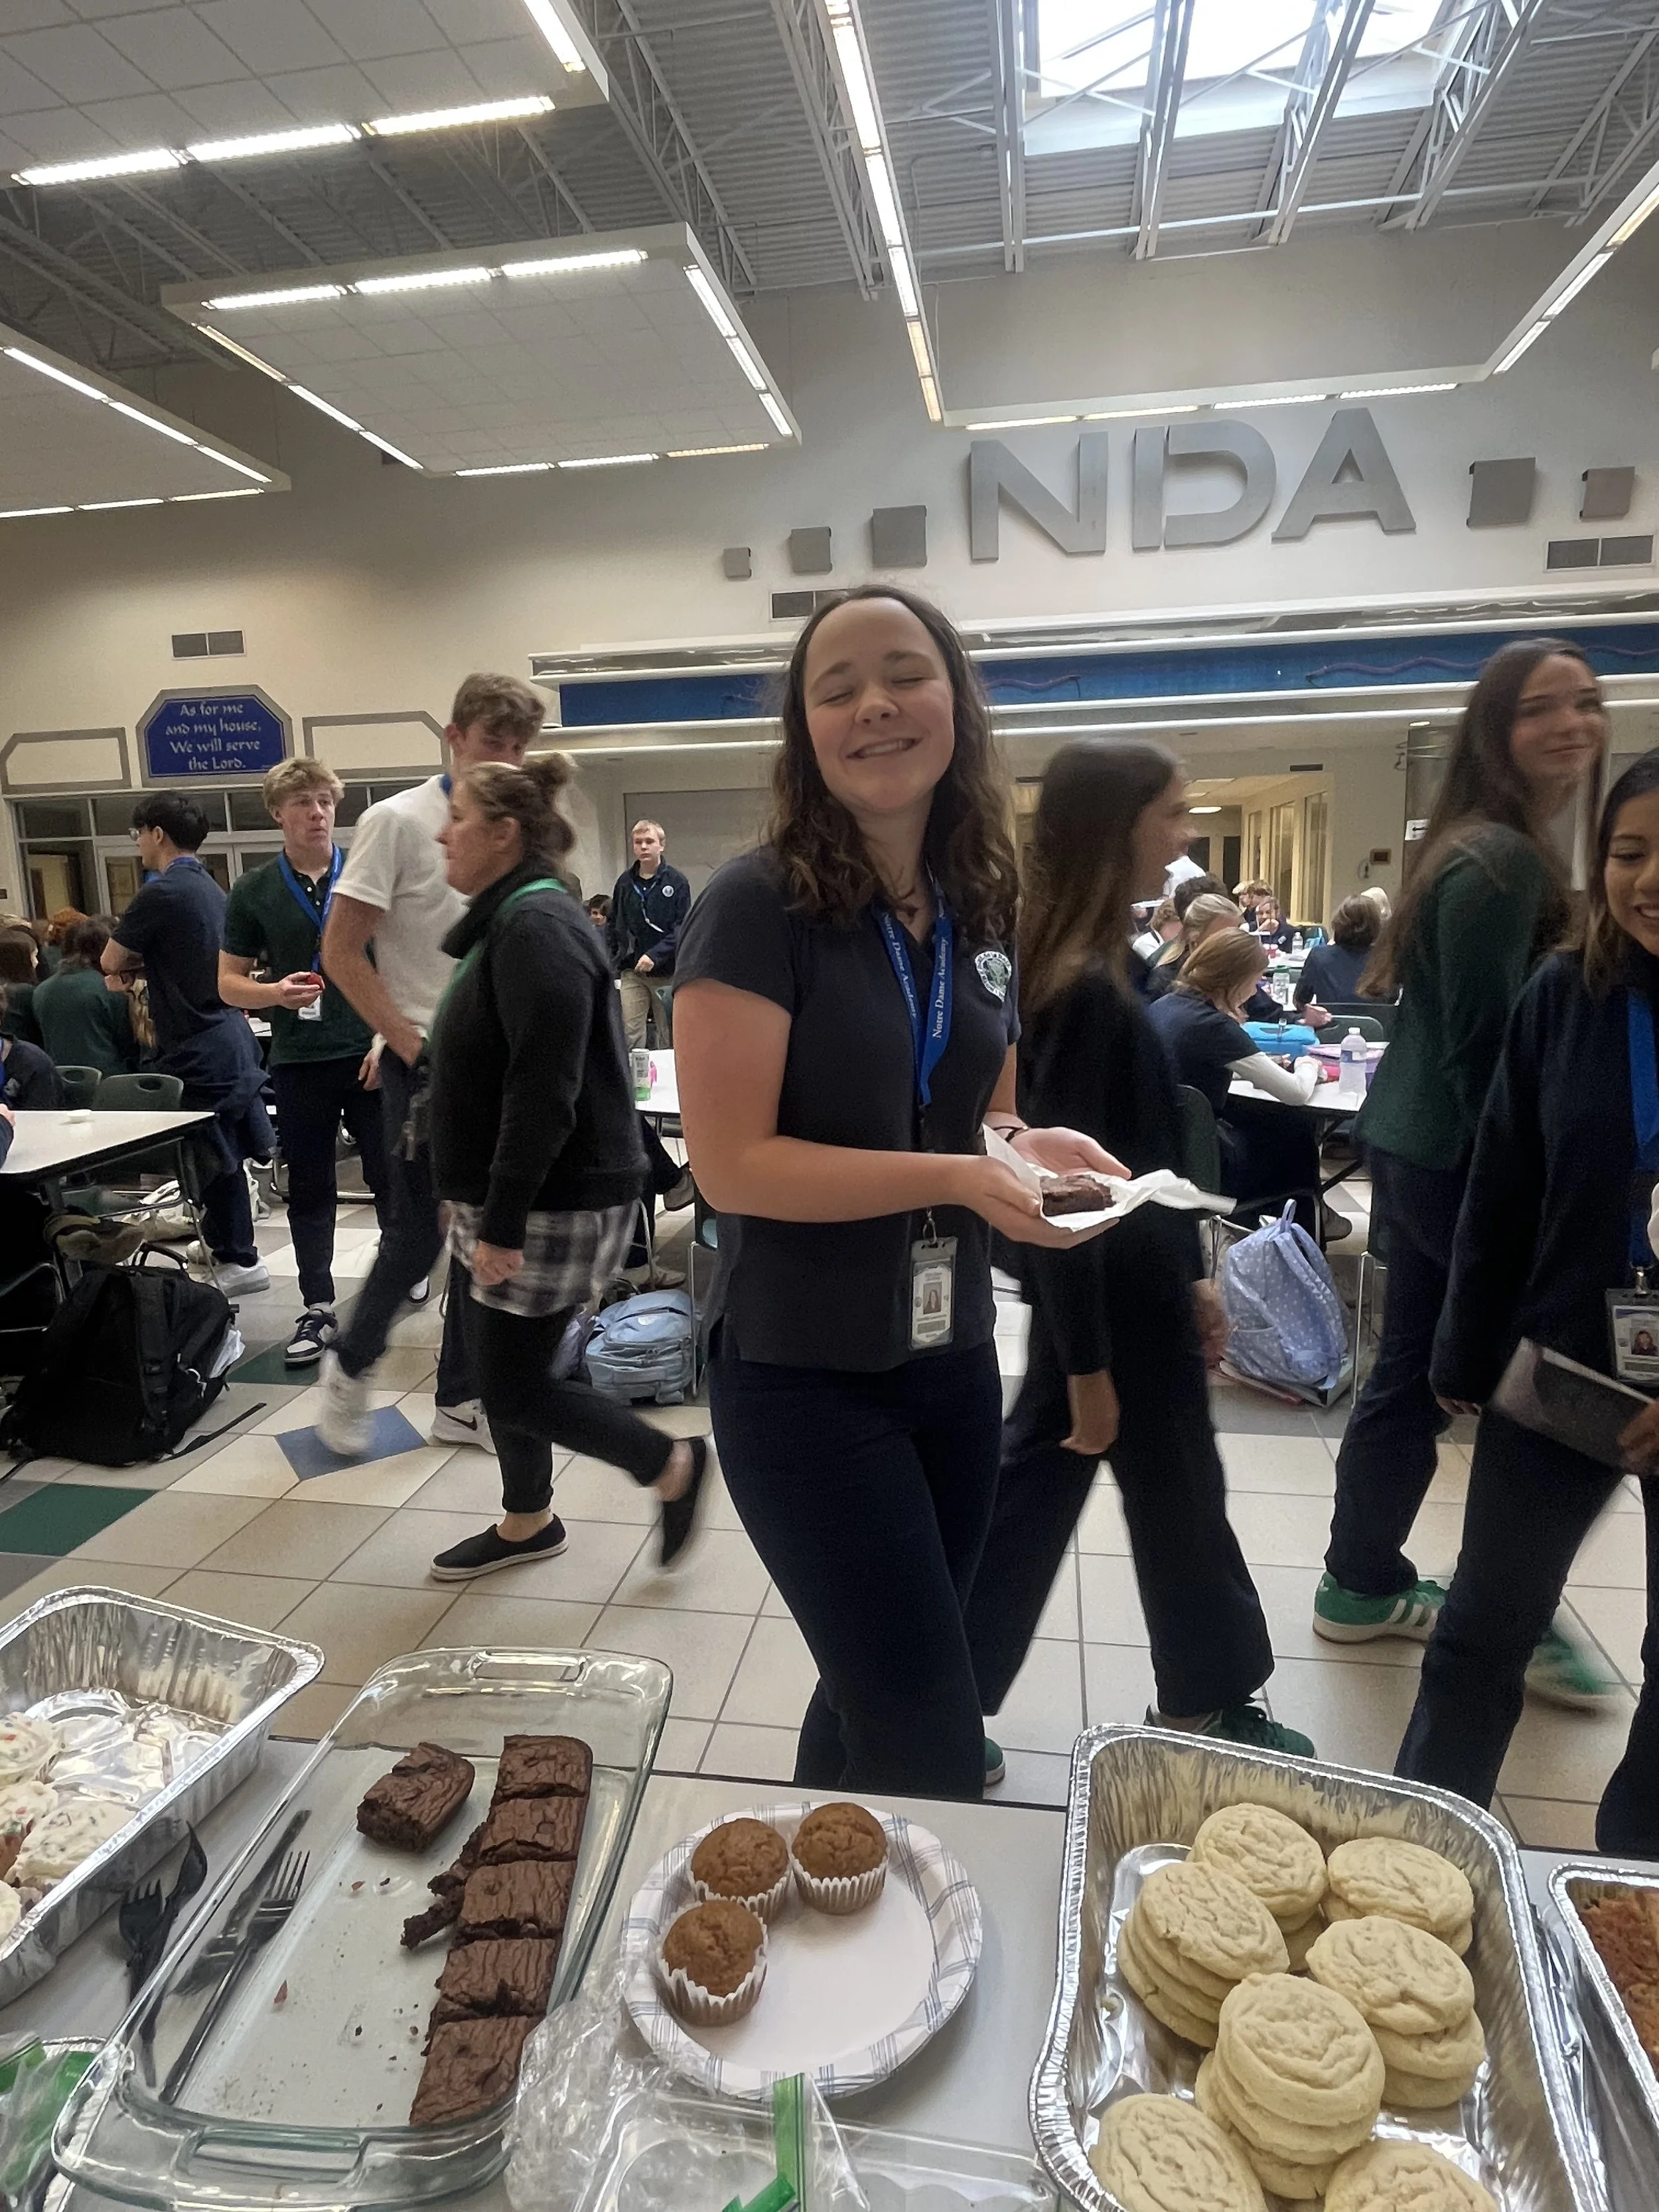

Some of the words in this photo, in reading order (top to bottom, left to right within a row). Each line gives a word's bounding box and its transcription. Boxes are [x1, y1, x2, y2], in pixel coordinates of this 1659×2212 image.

[970, 407, 1417, 561] NDA
[180, 704, 196, 717] As
[200, 701, 218, 715] for
[223, 703, 244, 714] me
[165, 723, 190, 735] and
[194, 723, 216, 736] my
[219, 718, 261, 732] house,
[170, 741, 192, 753] We
[196, 738, 222, 753] will
[226, 741, 260, 751] serve
[188, 757, 208, 770] the
[212, 757, 246, 769] Lord.
[938, 936, 948, 979] Academy
[892, 941, 905, 972] Dame
[902, 974, 916, 1019] Academy
[935, 982, 945, 1008] Dame
[932, 1011, 944, 1039] Notre
